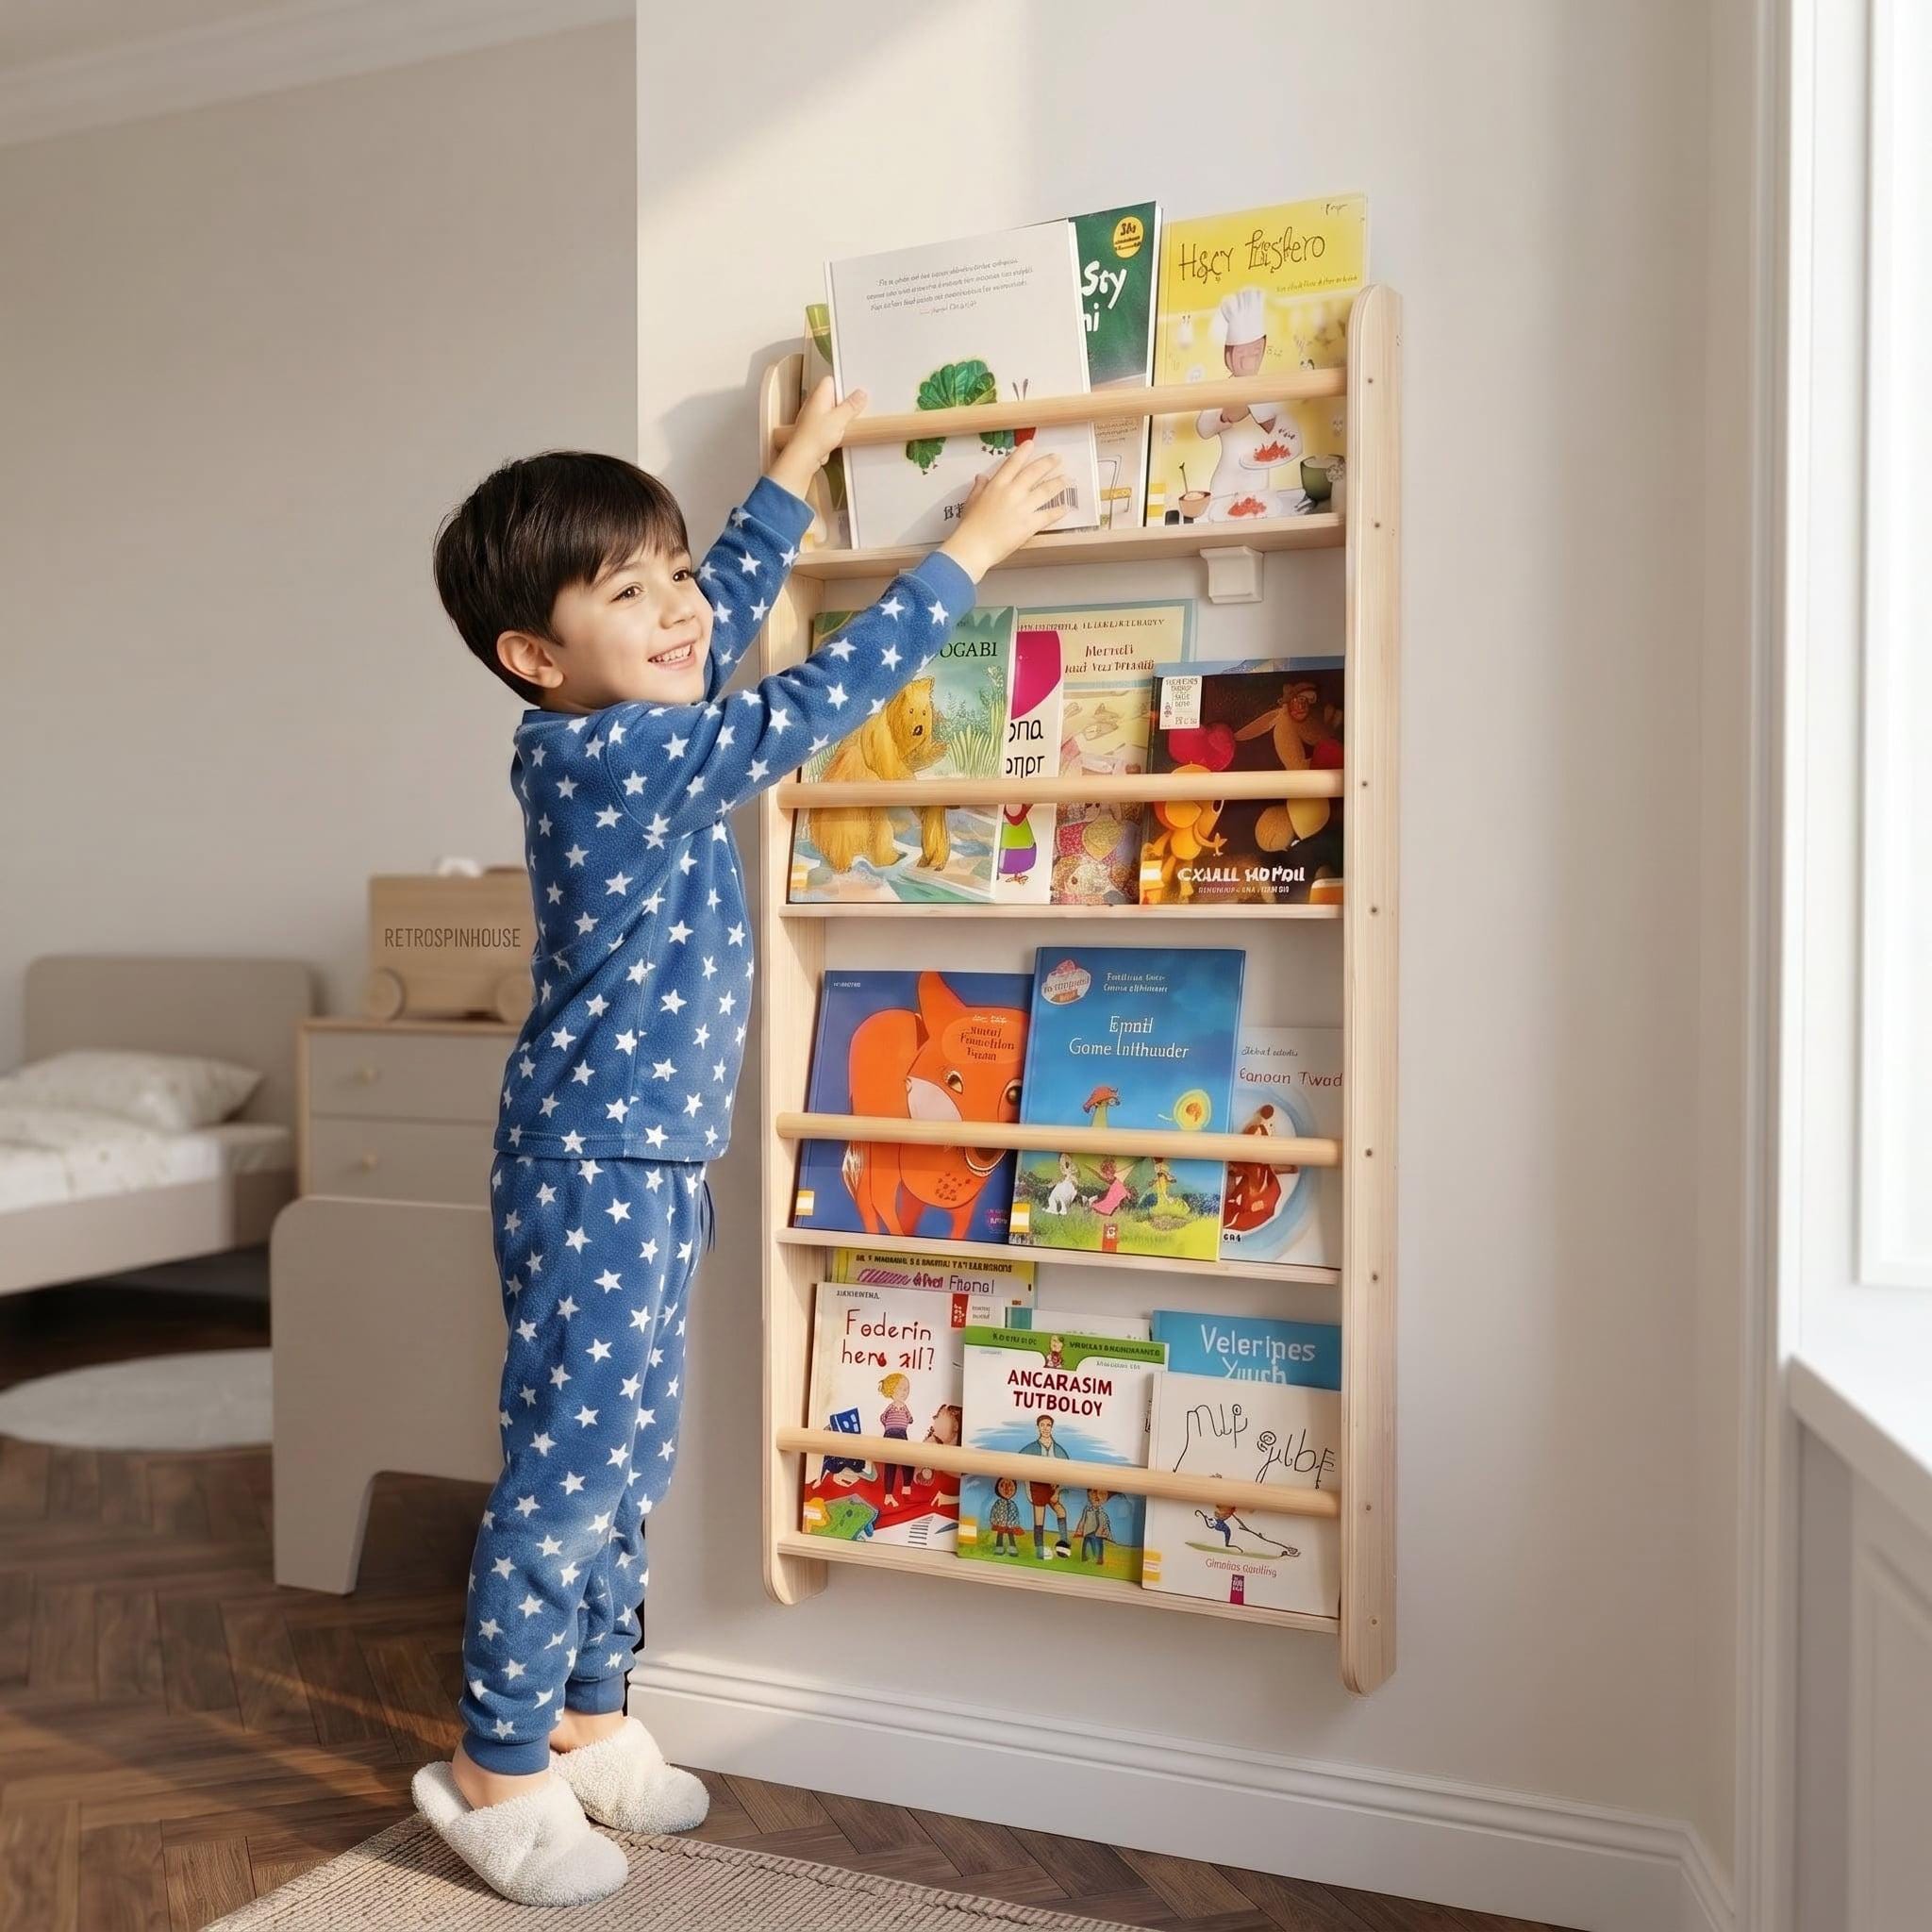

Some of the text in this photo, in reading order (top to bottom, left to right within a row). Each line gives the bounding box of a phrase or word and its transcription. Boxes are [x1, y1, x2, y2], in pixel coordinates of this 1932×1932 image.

[384, 927, 521, 948] RETROSPINHOUSE
[1008, 1369, 1113, 1396] ANCARASIM
[1012, 1391, 1103, 1417] TUTBOLOY
